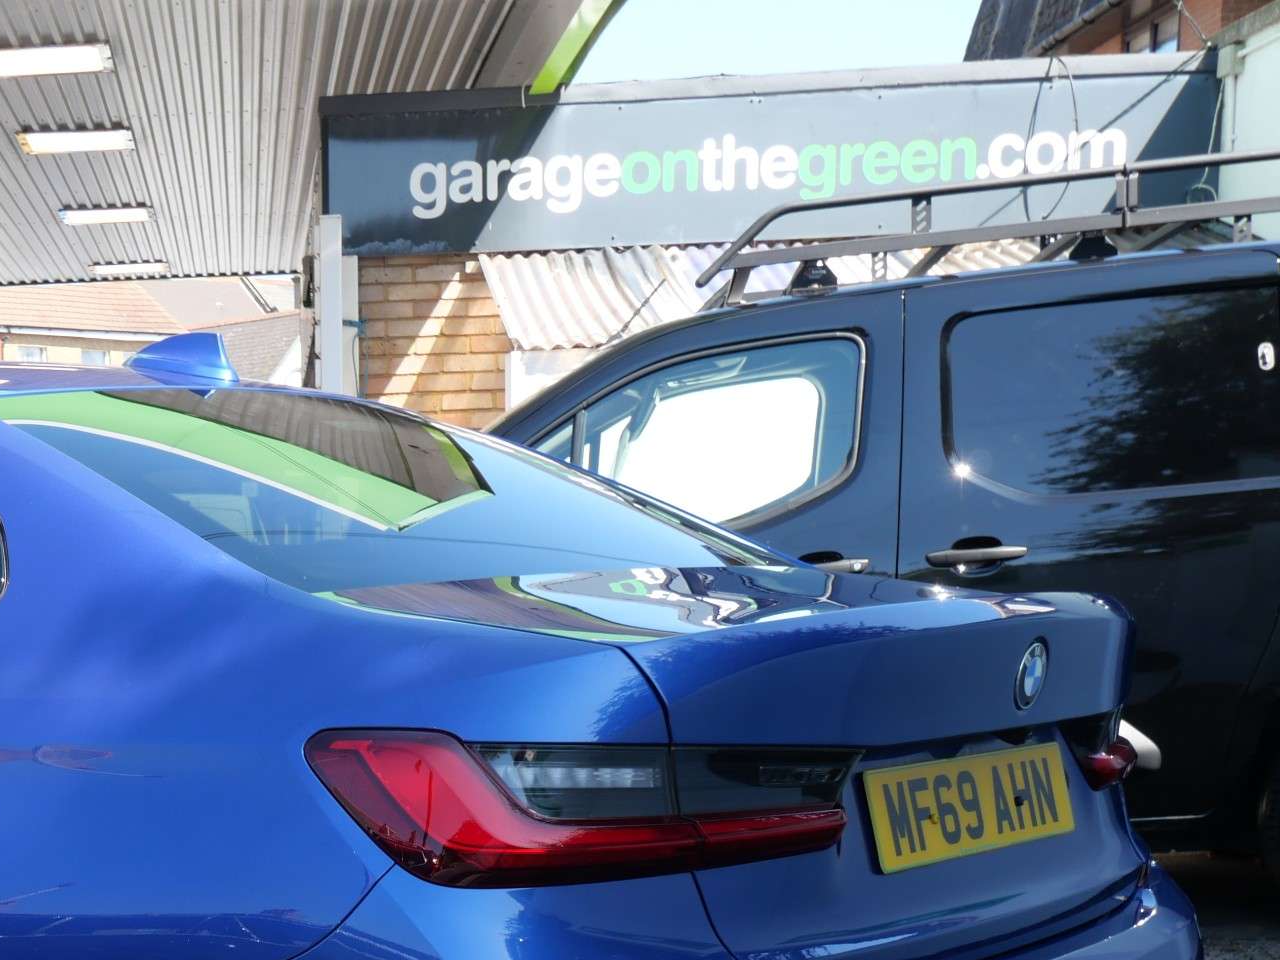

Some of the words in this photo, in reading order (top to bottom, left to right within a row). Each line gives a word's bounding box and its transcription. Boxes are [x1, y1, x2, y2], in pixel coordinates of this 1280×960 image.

[409, 128, 1128, 220] garageonthegreen.com
[882, 770, 985, 857] MF69
[991, 757, 1059, 835] AHN
